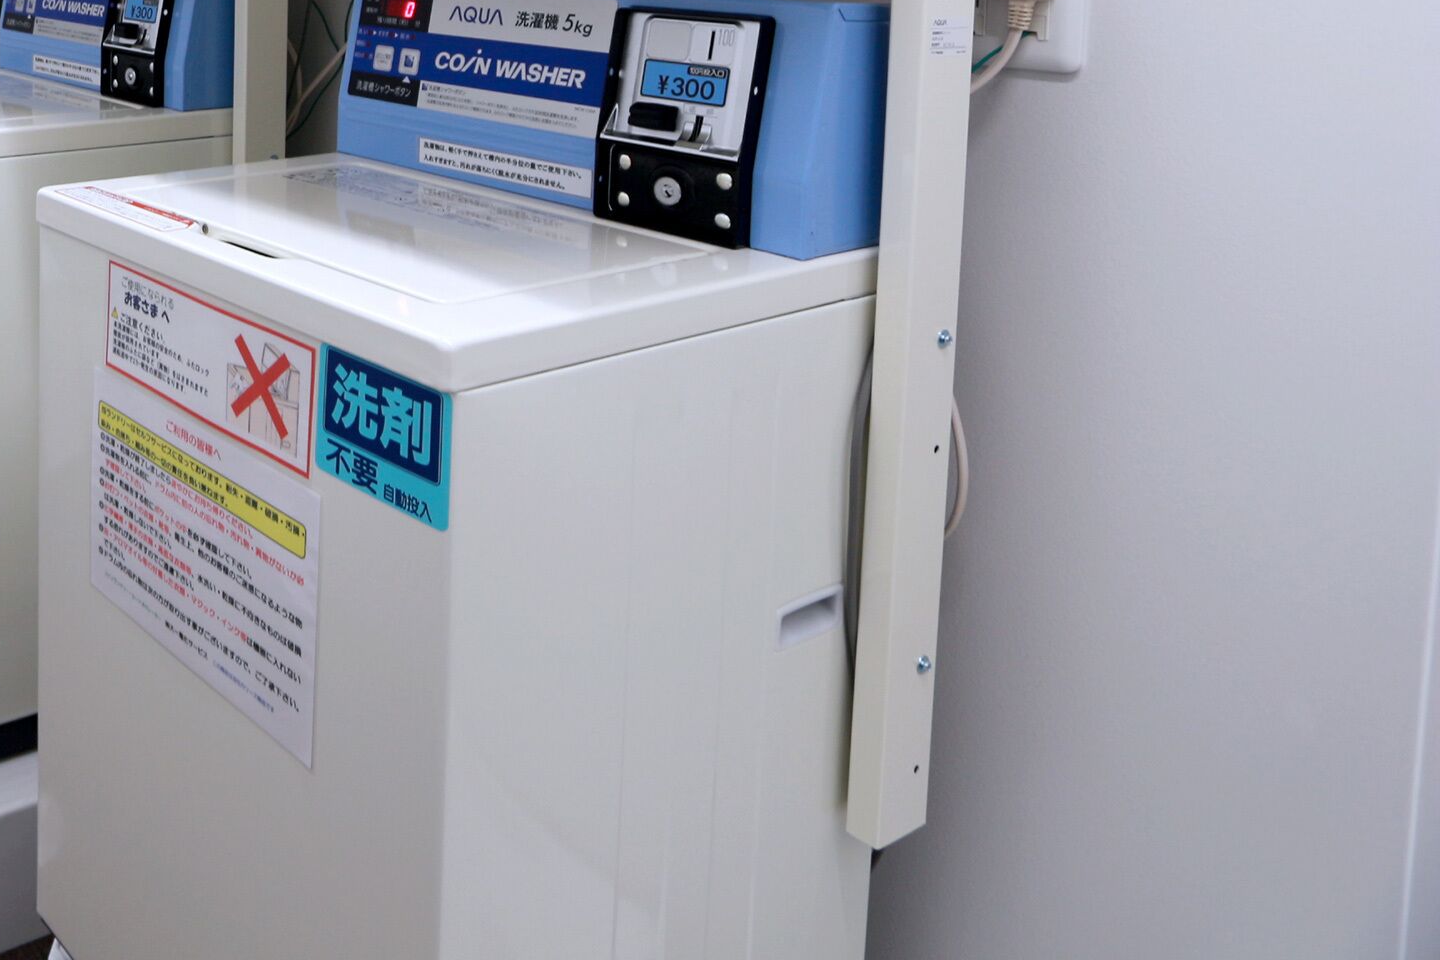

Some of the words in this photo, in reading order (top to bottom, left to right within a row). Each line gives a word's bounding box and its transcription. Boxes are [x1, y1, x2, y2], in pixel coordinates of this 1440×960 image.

[67, 1, 105, 17] WASHER
[404, 1, 416, 18] 0
[449, 5, 503, 26] AQUA
[515, 10, 559, 30] 洗濯機
[562, 13, 593, 37] 5kg
[435, 48, 491, 76] COIN
[496, 59, 586, 89] WASHER
[658, 74, 715, 100] ¥300
[124, 290, 158, 319] お客さま
[161, 310, 170, 323] へ
[120, 312, 165, 343] ご注意ください。
[331, 362, 432, 467] 洗剤
[165, 420, 221, 462] ご利用の皆様へ
[325, 437, 379, 495] 不要
[383, 482, 432, 524] 自動投入
